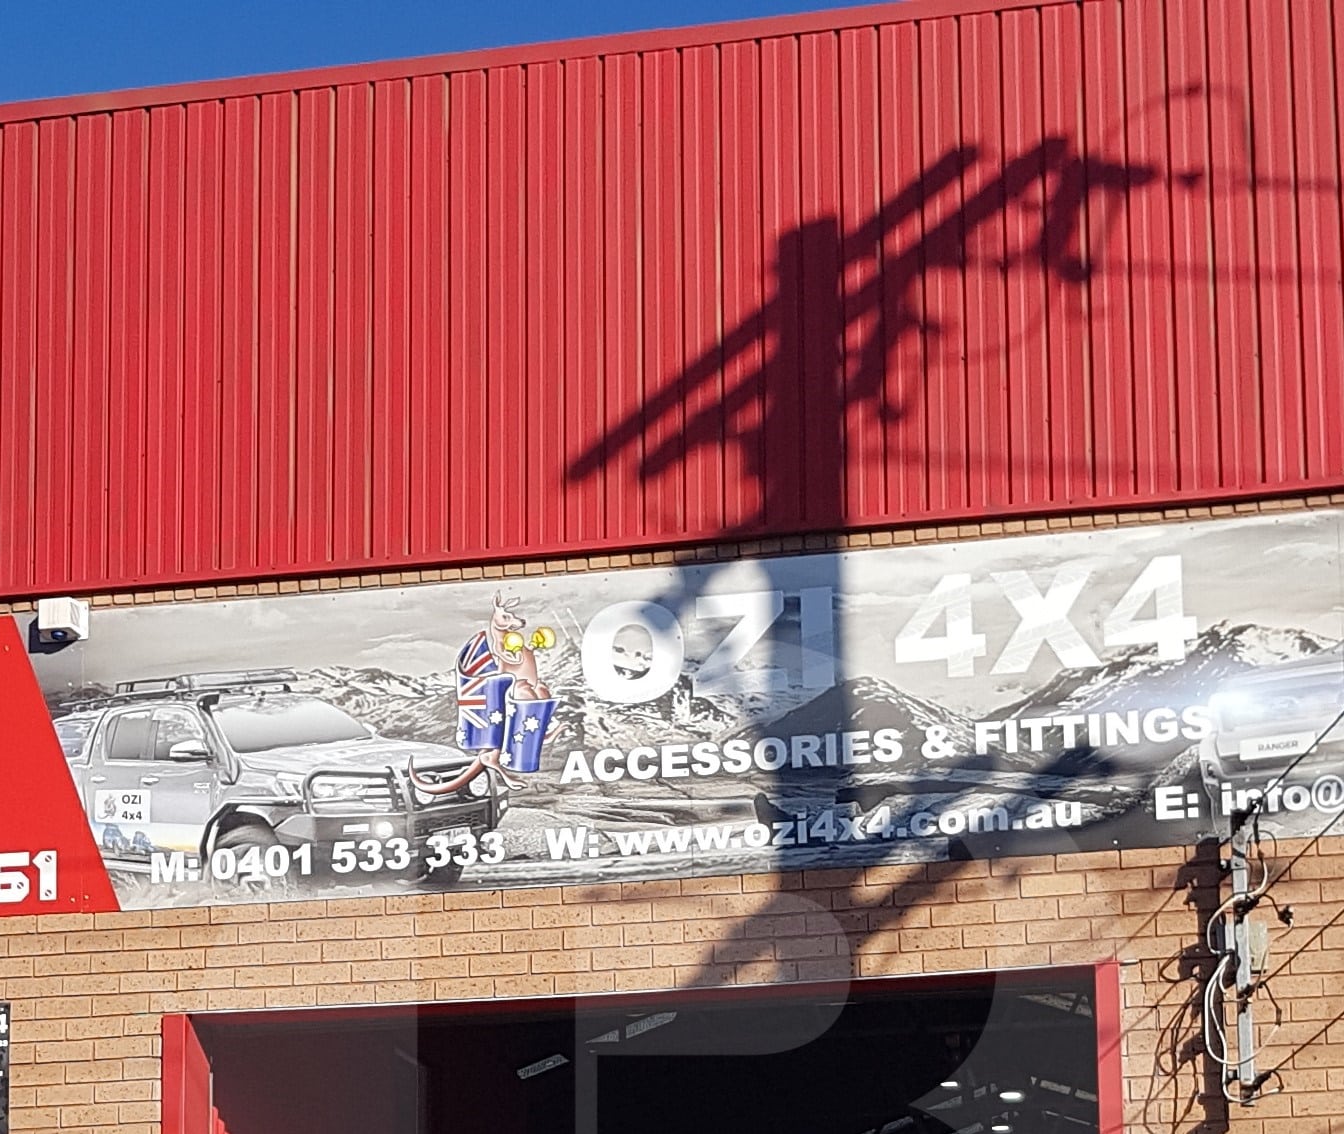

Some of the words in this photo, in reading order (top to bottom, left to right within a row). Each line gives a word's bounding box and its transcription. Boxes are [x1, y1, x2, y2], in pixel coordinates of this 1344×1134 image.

[581, 584, 836, 703] OZI
[895, 554, 1198, 680] 4X4
[559, 727, 902, 785] ACCESSORIES
[920, 725, 956, 760] &
[976, 706, 1214, 755] FITTINGS
[1258, 740, 1298, 751] RANGER
[121, 794, 142, 805] OZI
[121, 810, 142, 820] 4x4
[1155, 786, 1197, 820] E:
[546, 828, 600, 861] W:
[616, 799, 1082, 857] www.ozi4x4.com.au
[151, 851, 199, 884] M:
[212, 845, 312, 881] 0401
[331, 838, 411, 874] 533
[426, 832, 505, 868] 333
